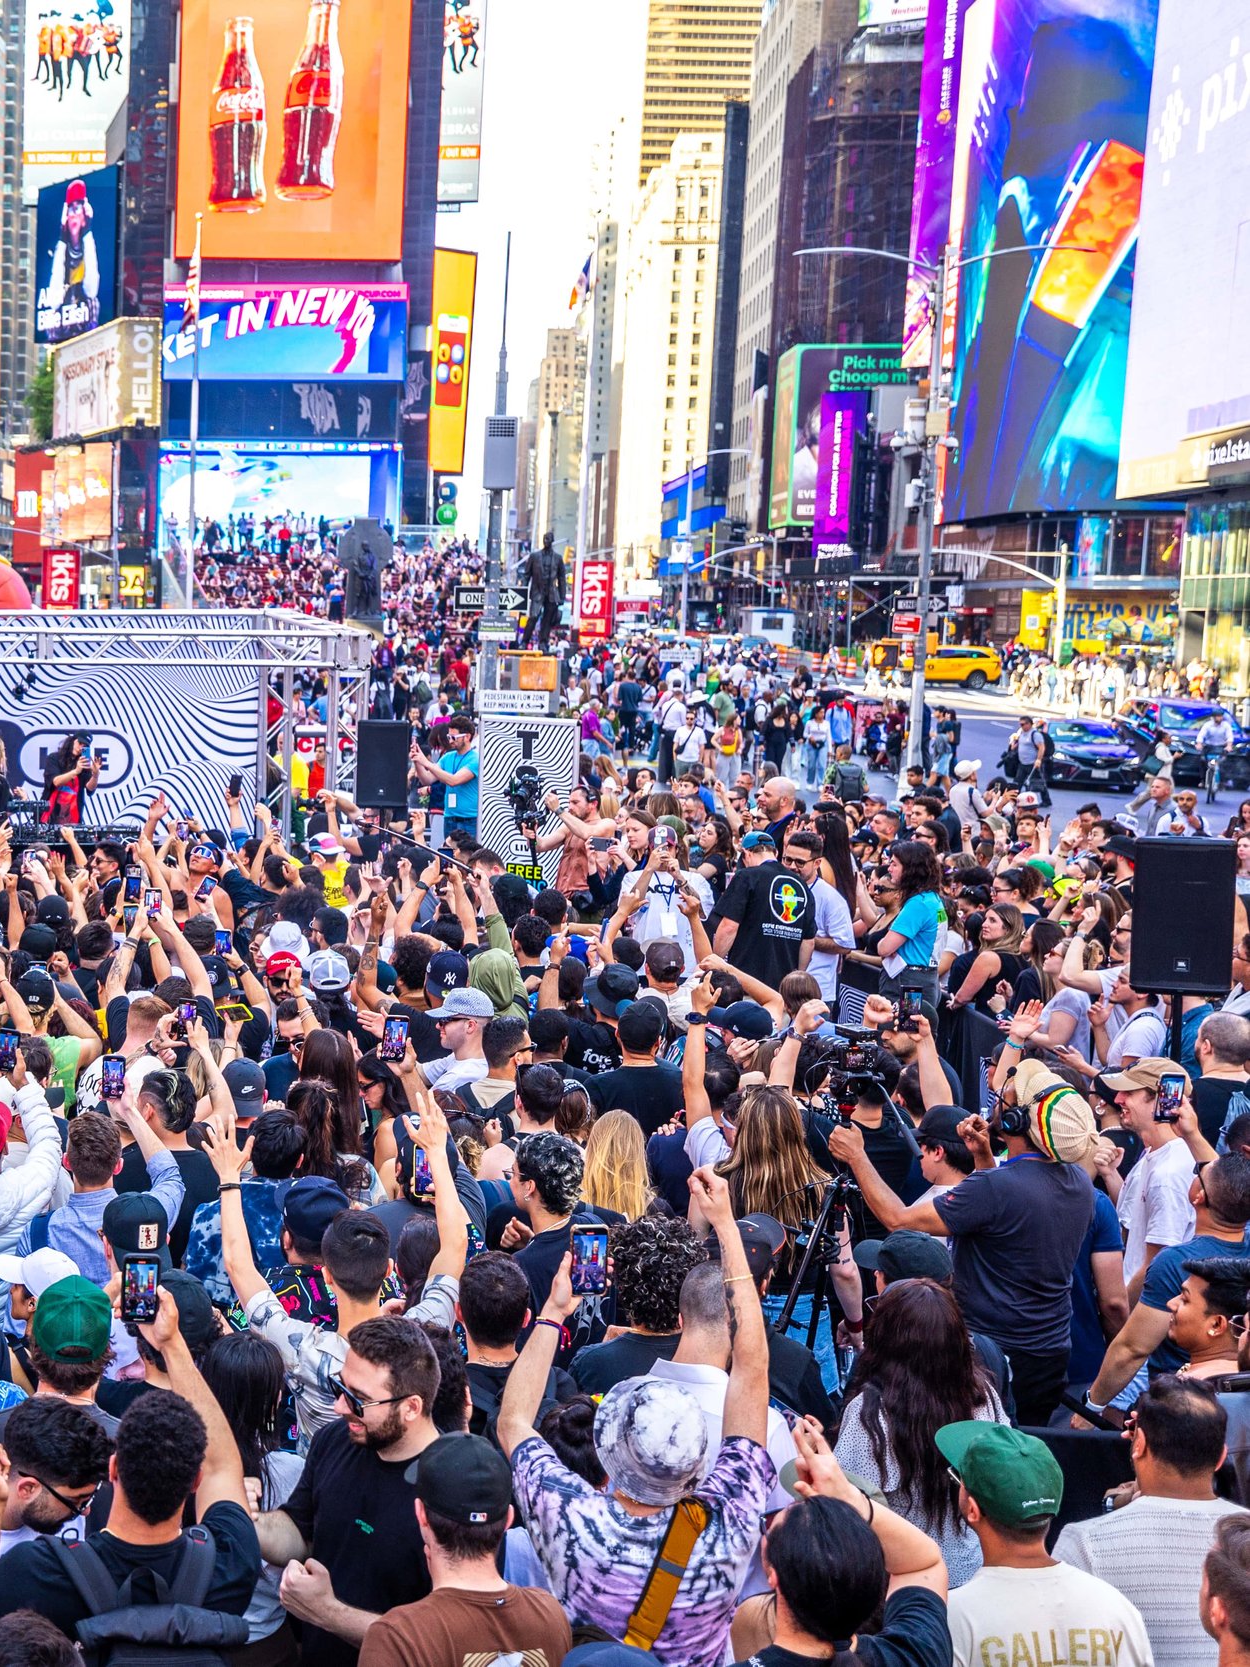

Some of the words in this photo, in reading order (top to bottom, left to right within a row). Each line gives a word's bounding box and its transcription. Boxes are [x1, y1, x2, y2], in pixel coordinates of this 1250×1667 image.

[226, 297, 269, 339] IN
[273, 287, 355, 327] NEW
[843, 356, 876, 369] Pick
[132, 324, 154, 420] HELLO!
[828, 370, 890, 384] Choose
[892, 372, 908, 383] m
[832, 452, 841, 470] FOR
[51, 552, 76, 602] tkts
[582, 564, 609, 615] tkts
[465, 594, 484, 603] ONE
[515, 843, 530, 851] LIV
[507, 864, 542, 879] FREE
[444, 971, 456, 986] NY
[980, 1628, 1125, 1667] GALLERY
